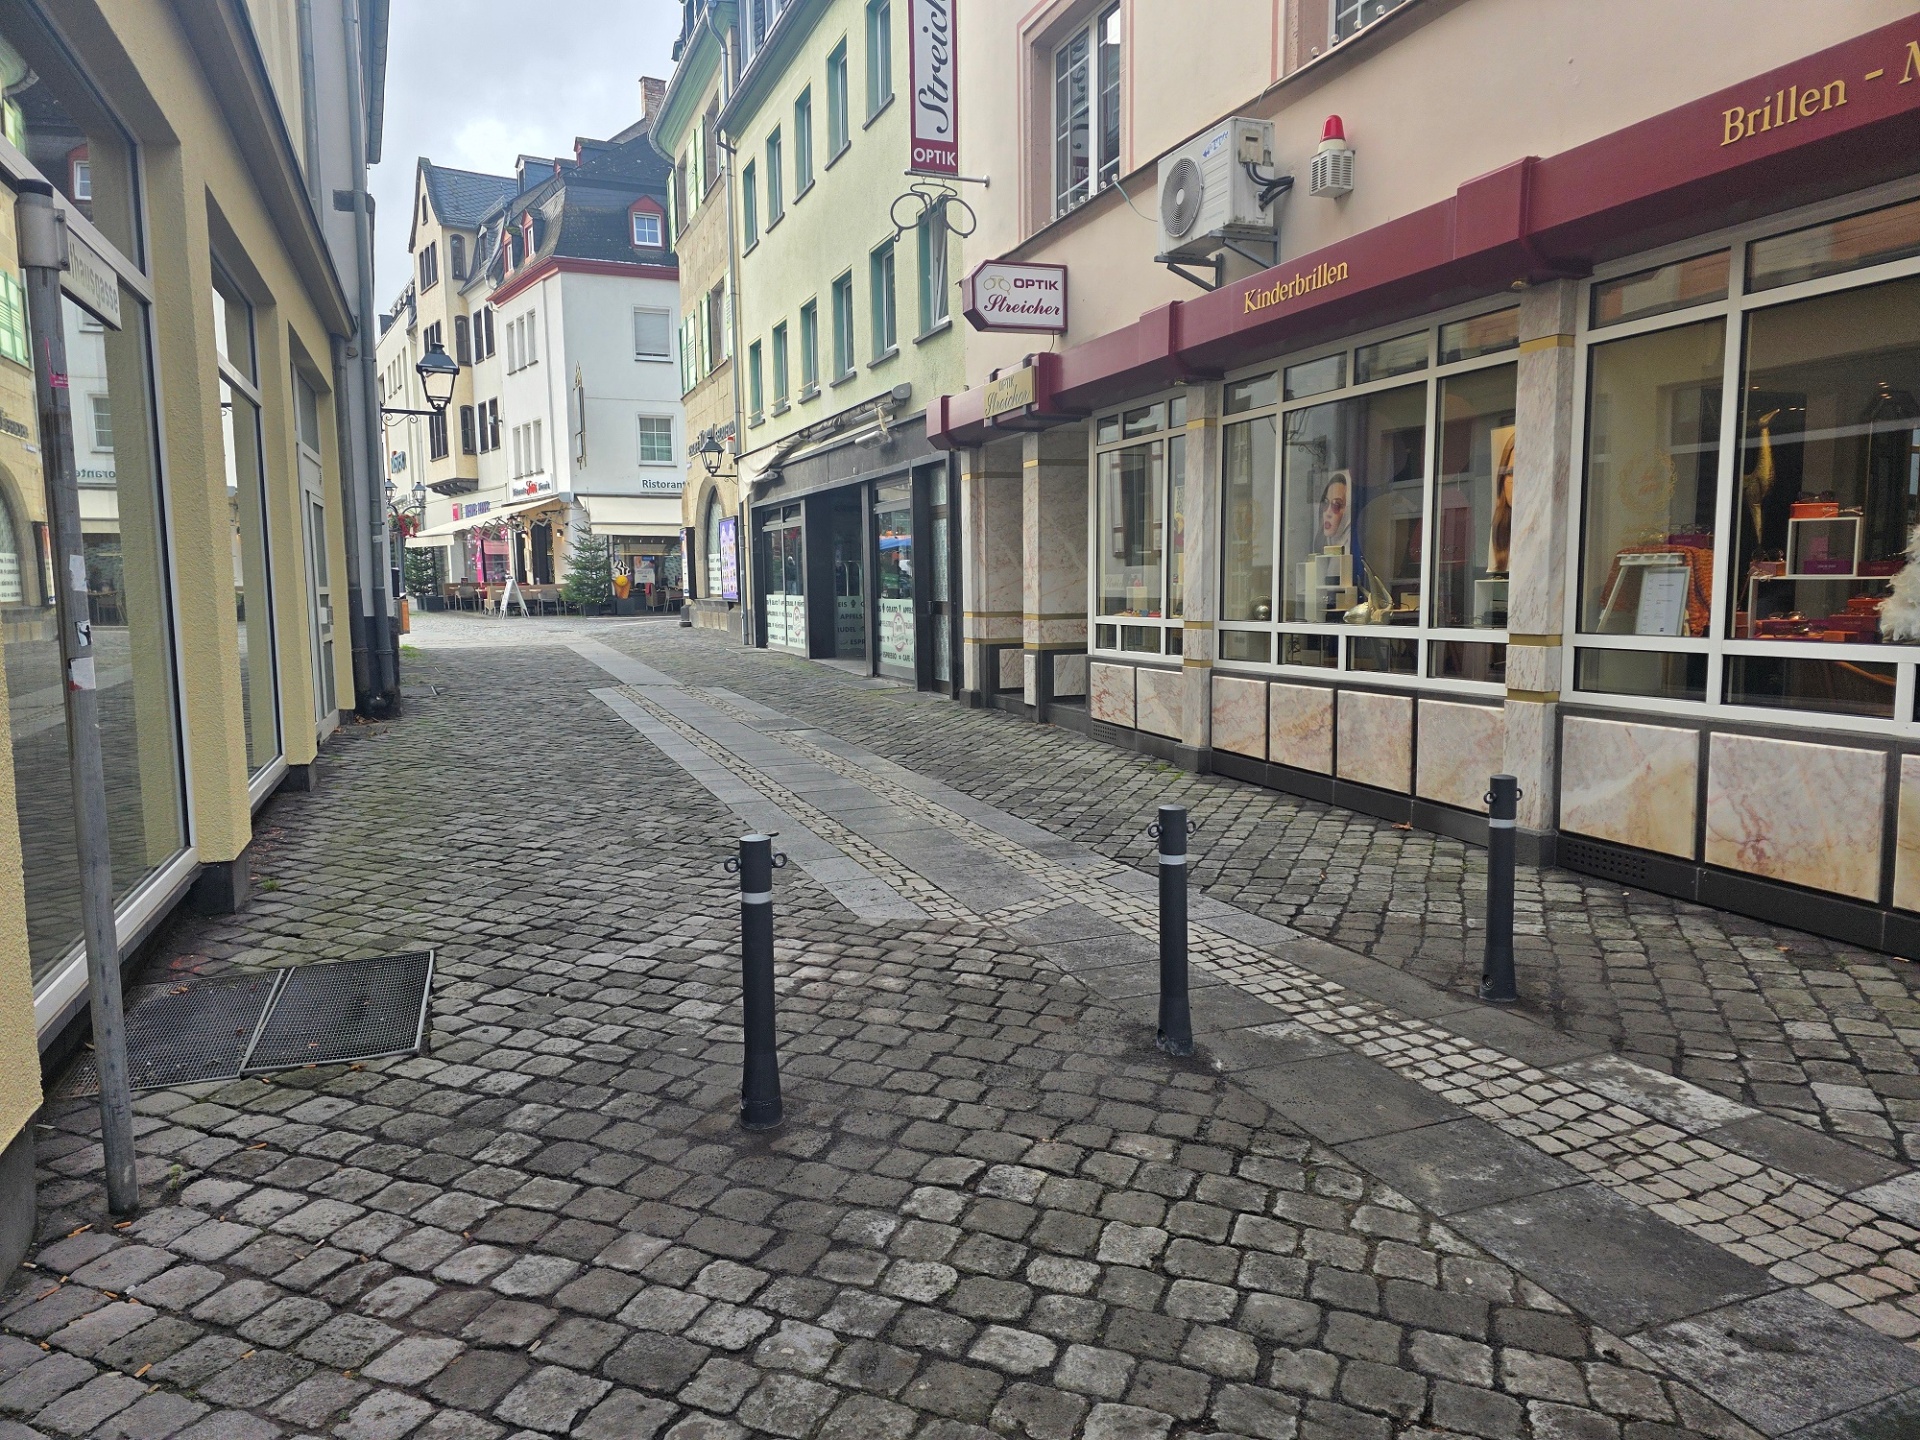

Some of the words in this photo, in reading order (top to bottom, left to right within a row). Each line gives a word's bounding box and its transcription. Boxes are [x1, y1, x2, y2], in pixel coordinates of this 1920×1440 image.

[1720, 79, 1848, 147] Brillen
[914, 147, 956, 166] OPTIK
[67, 241, 118, 314] thausgasse
[1013, 278, 1059, 291] OPTIK
[1243, 262, 1349, 314] Kinderbrillen
[984, 294, 1060, 315] Streicher
[998, 375, 1015, 391] OPTIK
[985, 384, 1031, 416] Streicher
